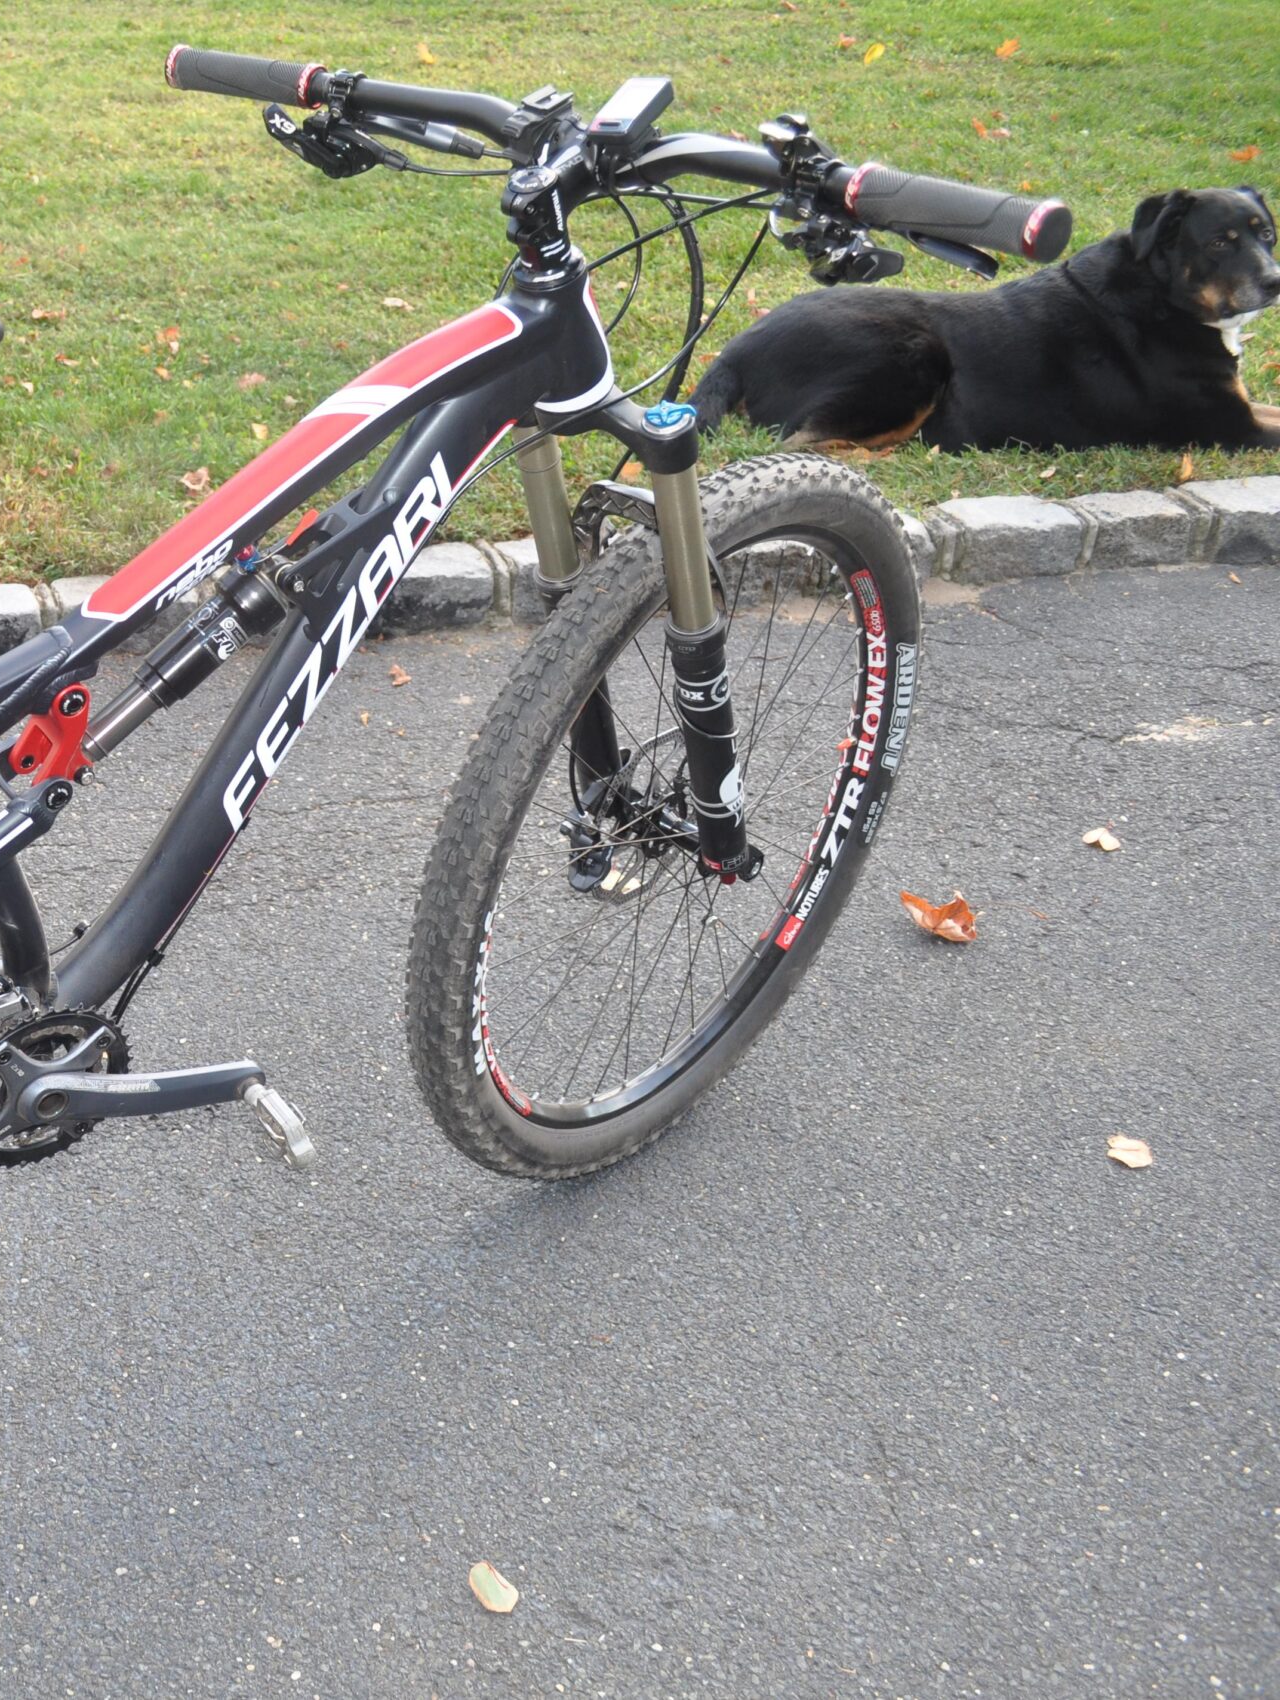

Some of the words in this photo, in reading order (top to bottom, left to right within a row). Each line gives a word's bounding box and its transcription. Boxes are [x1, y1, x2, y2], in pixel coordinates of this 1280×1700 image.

[269, 113, 297, 135] X9
[155, 539, 234, 611] nebo
[222, 451, 454, 832] FEZZARI
[866, 629, 888, 669] EX
[678, 686, 705, 701] OX
[852, 673, 887, 773] FLOW
[881, 642, 918, 778] ARDENT
[820, 777, 866, 868] ZTR
[794, 868, 830, 922] NOTUBES
